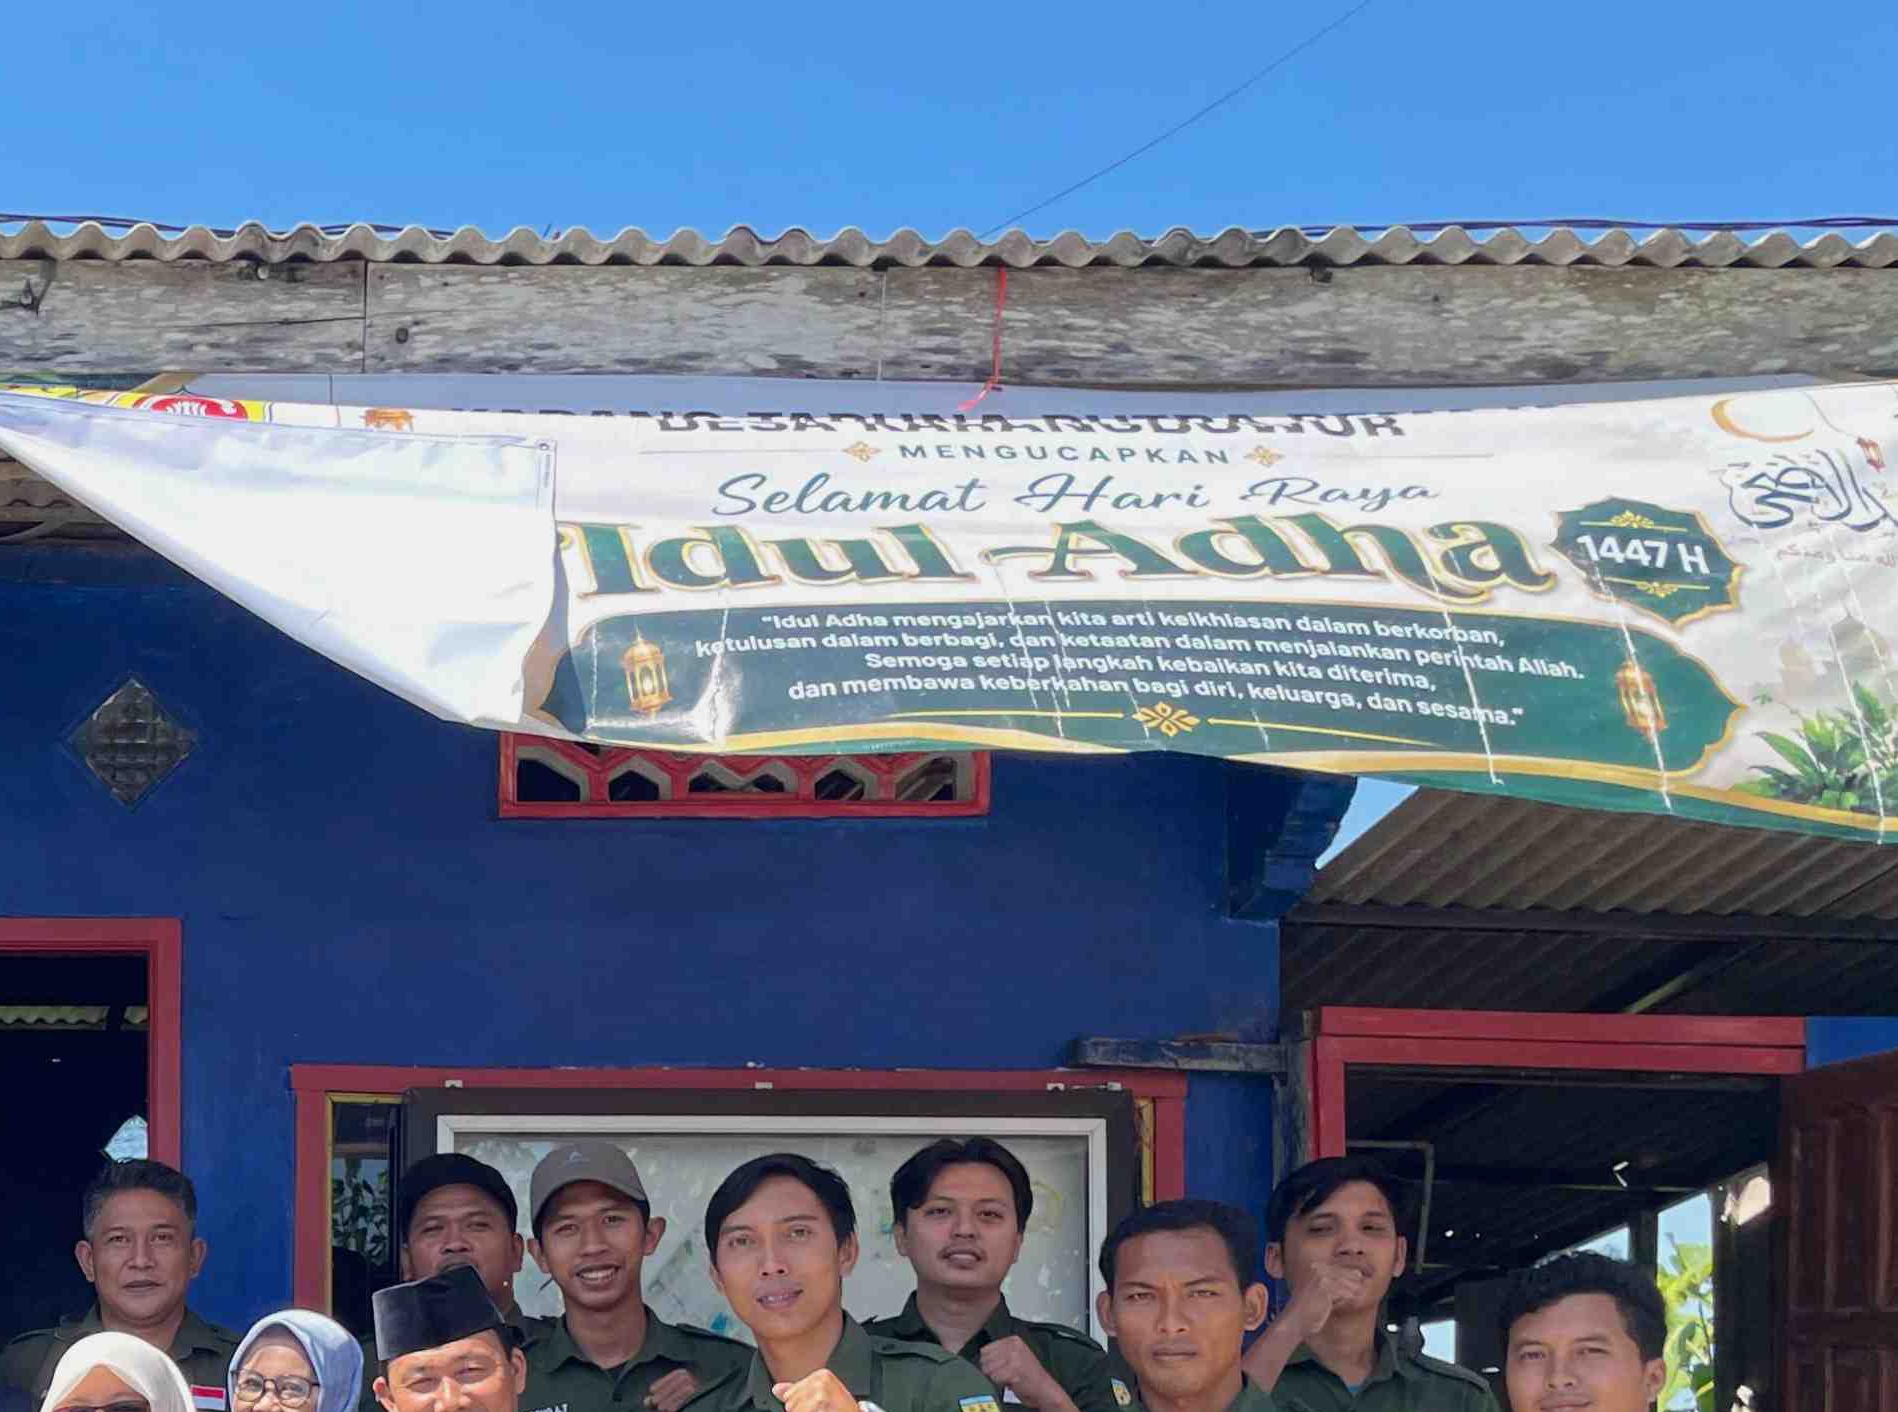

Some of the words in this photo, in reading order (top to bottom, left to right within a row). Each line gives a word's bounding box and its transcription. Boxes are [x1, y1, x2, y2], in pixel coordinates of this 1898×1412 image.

[897, 443, 1230, 465] MENGUCAPKAN
[711, 472, 989, 517] Selamat
[1013, 472, 1212, 514] Hari
[1239, 475, 1440, 514] Raya
[559, 517, 977, 600] Idul
[979, 512, 1559, 603] Adha
[1576, 533, 1670, 573] 1447
[1676, 542, 1711, 575] H
[825, 613, 888, 629] Adha
[892, 611, 1053, 634] mengajarkan
[1056, 610, 1106, 627] kita
[1111, 611, 1154, 627] arti
[1158, 611, 1291, 632] keikhlasan
[1296, 615, 1370, 637] dalam
[1374, 620, 1505, 648] berkorban,
[696, 634, 816, 658] ketulusan
[822, 633, 897, 650] dalam
[901, 631, 1005, 653] berbagi,
[1010, 632, 1055, 649] dan
[1060, 631, 1169, 650] ketaatan
[1175, 633, 1250, 654] dalam
[1255, 637, 1416, 664] menjalankan
[1415, 646, 1514, 675] perintah
[1517, 656, 1585, 681] Allah.
[866, 652, 967, 674] Semoga
[972, 652, 1050, 673] setiap
[1054, 652, 1152, 675] langkah
[1157, 654, 1271, 678] kebaikan
[1275, 659, 1323, 682] kita
[1327, 663, 1437, 695] diterima,
[788, 680, 837, 701] dan
[841, 675, 975, 698] membawa
[979, 673, 1129, 694] keberkahan
[1132, 677, 1187, 700] bagi
[1192, 679, 1244, 701] diri,
[1249, 683, 1362, 713] keluarga,
[1366, 692, 1413, 714] dan
